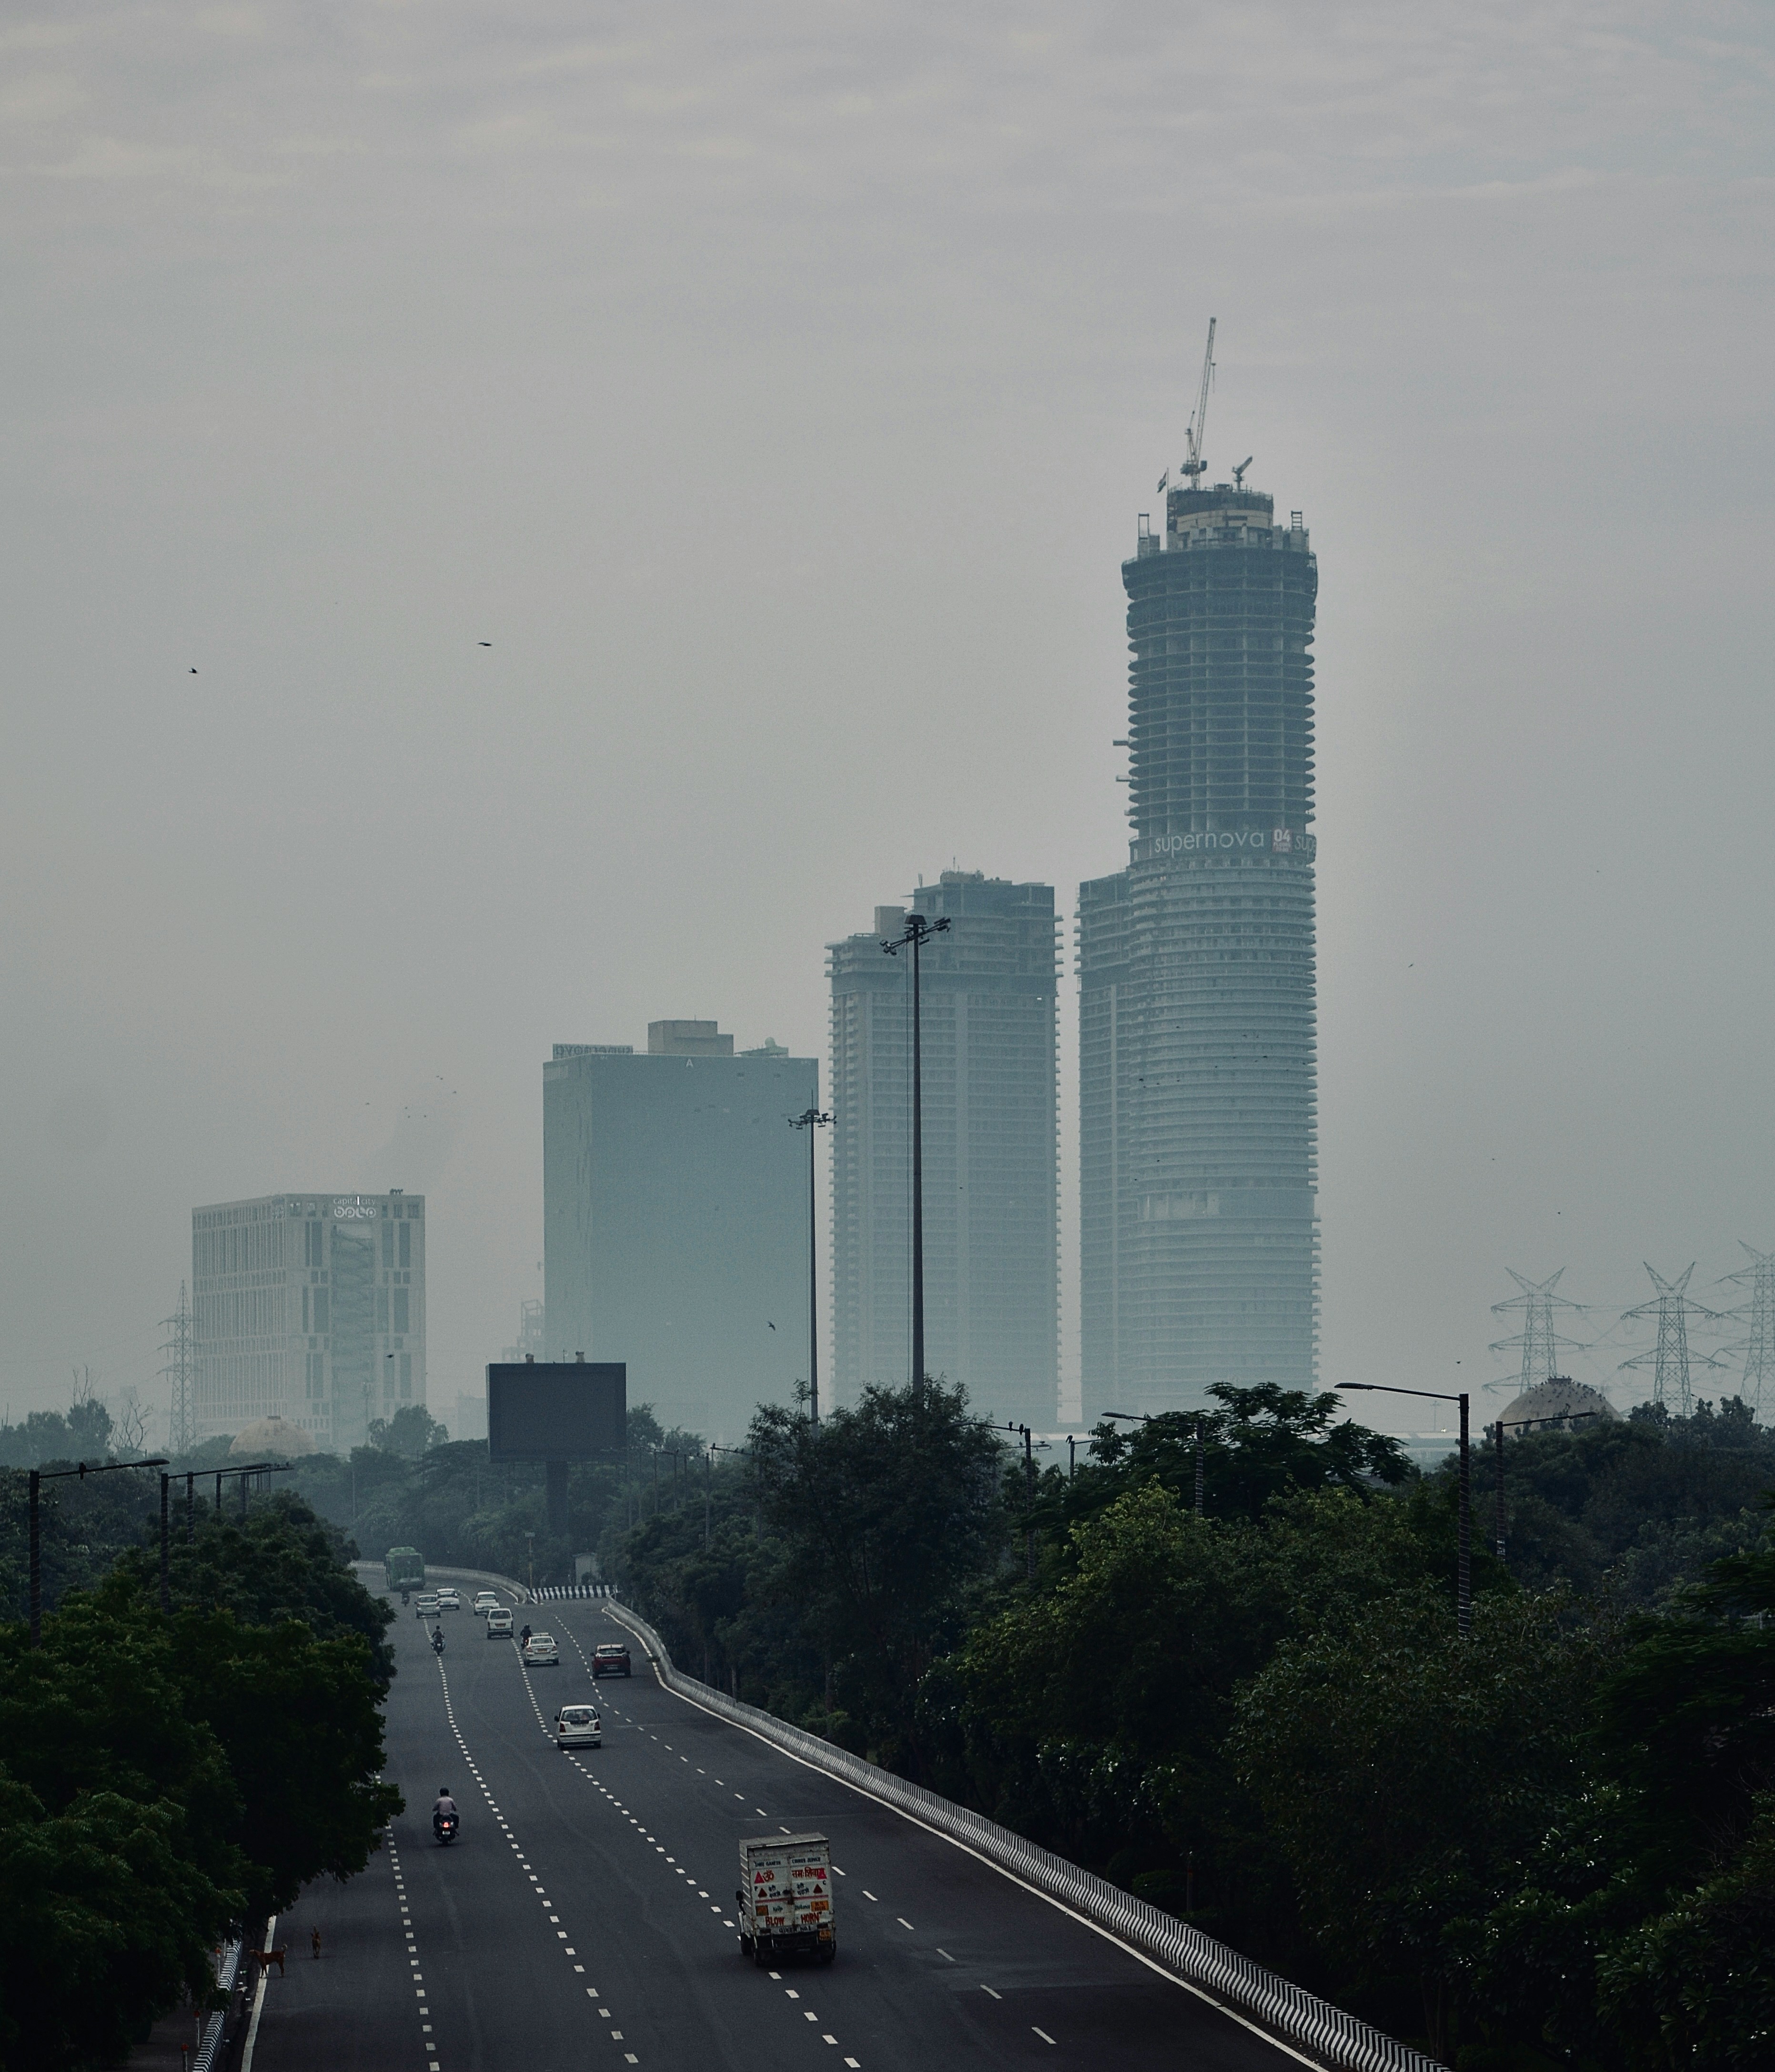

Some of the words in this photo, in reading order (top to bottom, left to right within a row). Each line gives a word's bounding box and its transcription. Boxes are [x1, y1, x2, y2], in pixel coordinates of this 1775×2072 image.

[1273, 829, 1291, 842] 04
[1155, 832, 1264, 859] supernova
[686, 1059, 694, 1067] A
[333, 1196, 360, 1206] capital
[765, 1916, 785, 1926] BLOW
[801, 1913, 820, 1923] HORN
